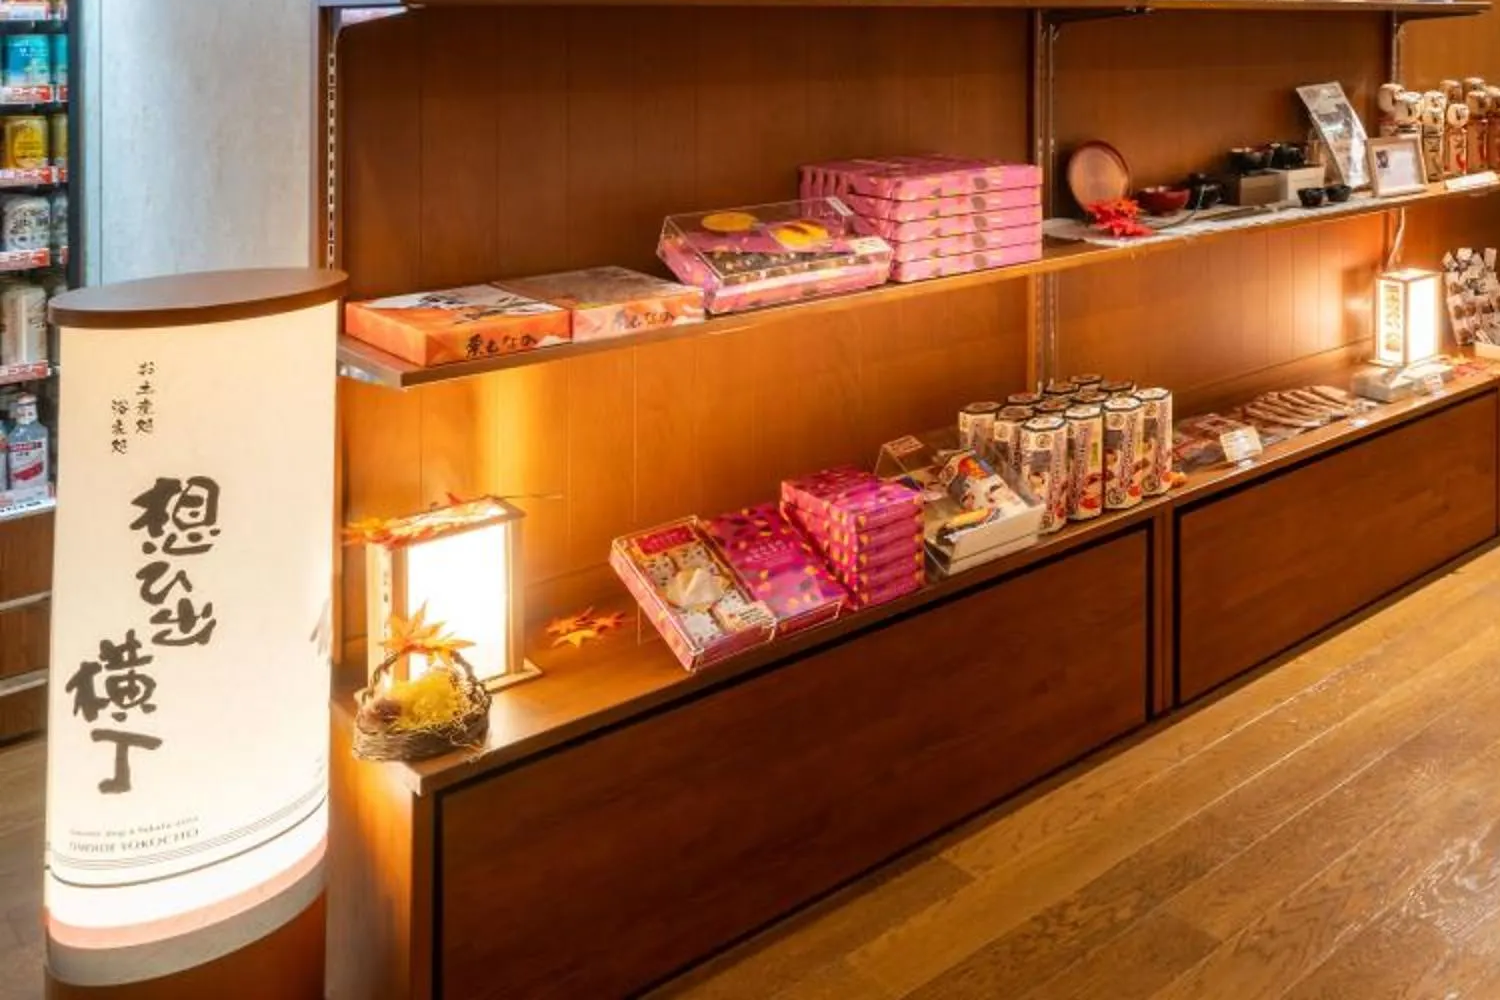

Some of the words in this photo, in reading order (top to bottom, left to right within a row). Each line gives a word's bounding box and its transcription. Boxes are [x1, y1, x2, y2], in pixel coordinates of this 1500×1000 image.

[136, 360, 156, 435] お土産処
[129, 475, 221, 647] 想ひ出
[65, 628, 163, 794] 横丁
